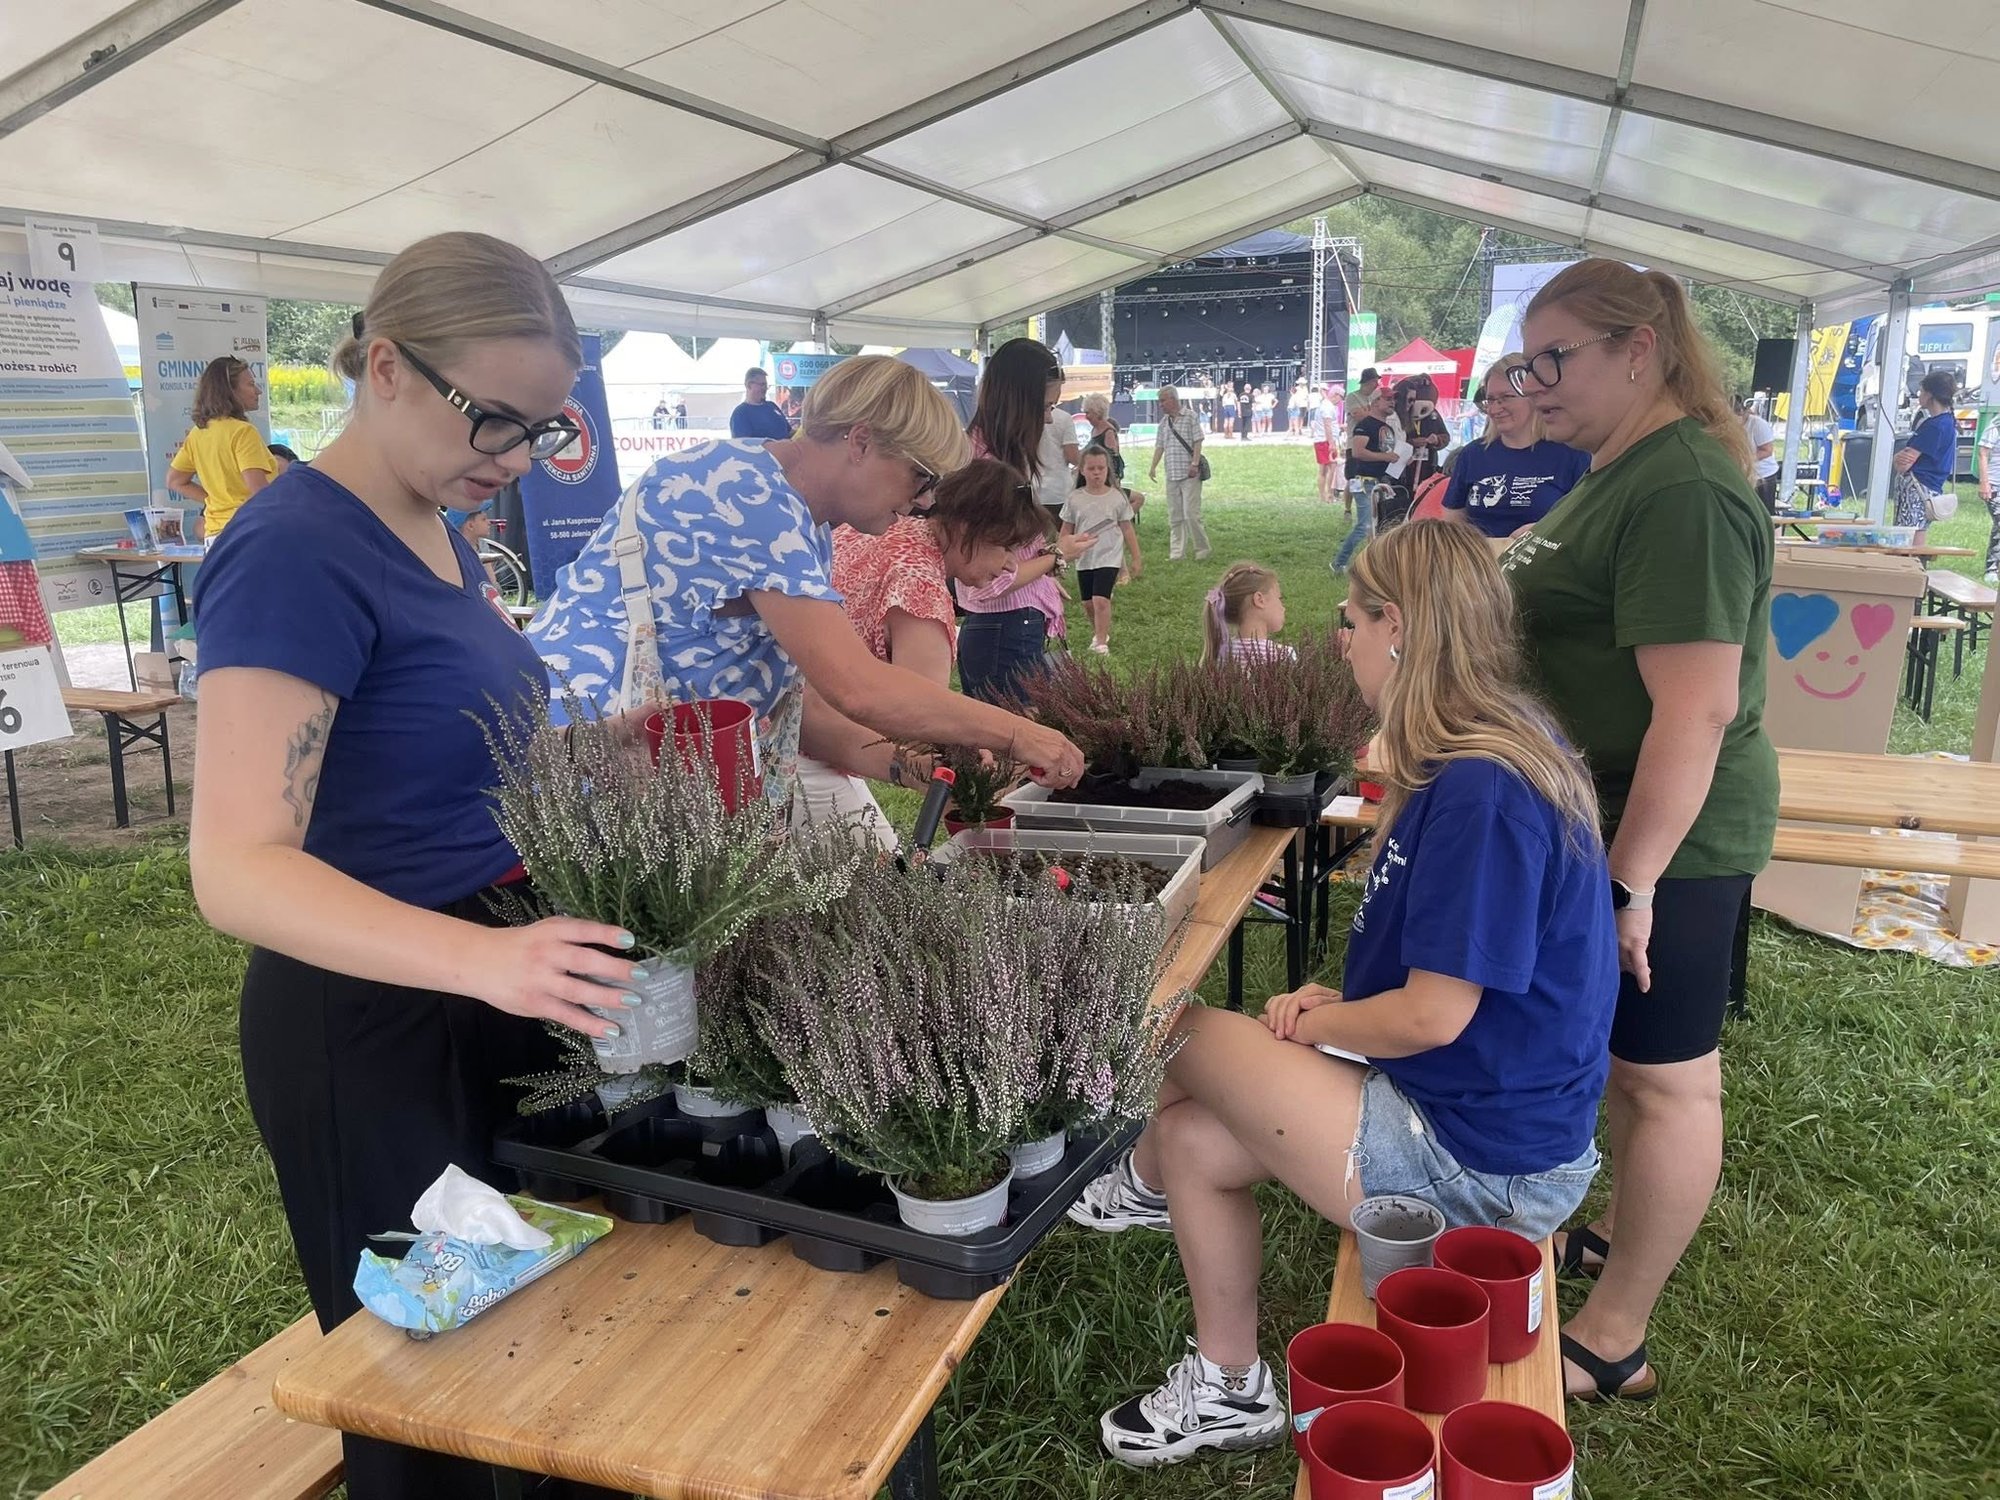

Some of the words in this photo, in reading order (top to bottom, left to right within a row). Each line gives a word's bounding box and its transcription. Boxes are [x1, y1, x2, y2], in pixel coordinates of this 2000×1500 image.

[58, 243, 76, 272] 9
[18, 277, 72, 298] wodę
[14, 297, 67, 311] pieniądze
[37, 363, 78, 374] zrobić?
[158, 360, 209, 378] GMINN
[572, 444, 597, 482] SANITARNA
[551, 518, 566, 526] Jana
[567, 516, 602, 526] Kasprowicza
[571, 529, 592, 538] Jelenia
[2, 658, 40, 671] terenowa
[0, 688, 22, 735] 6
[467, 1287, 507, 1308] Bobo
